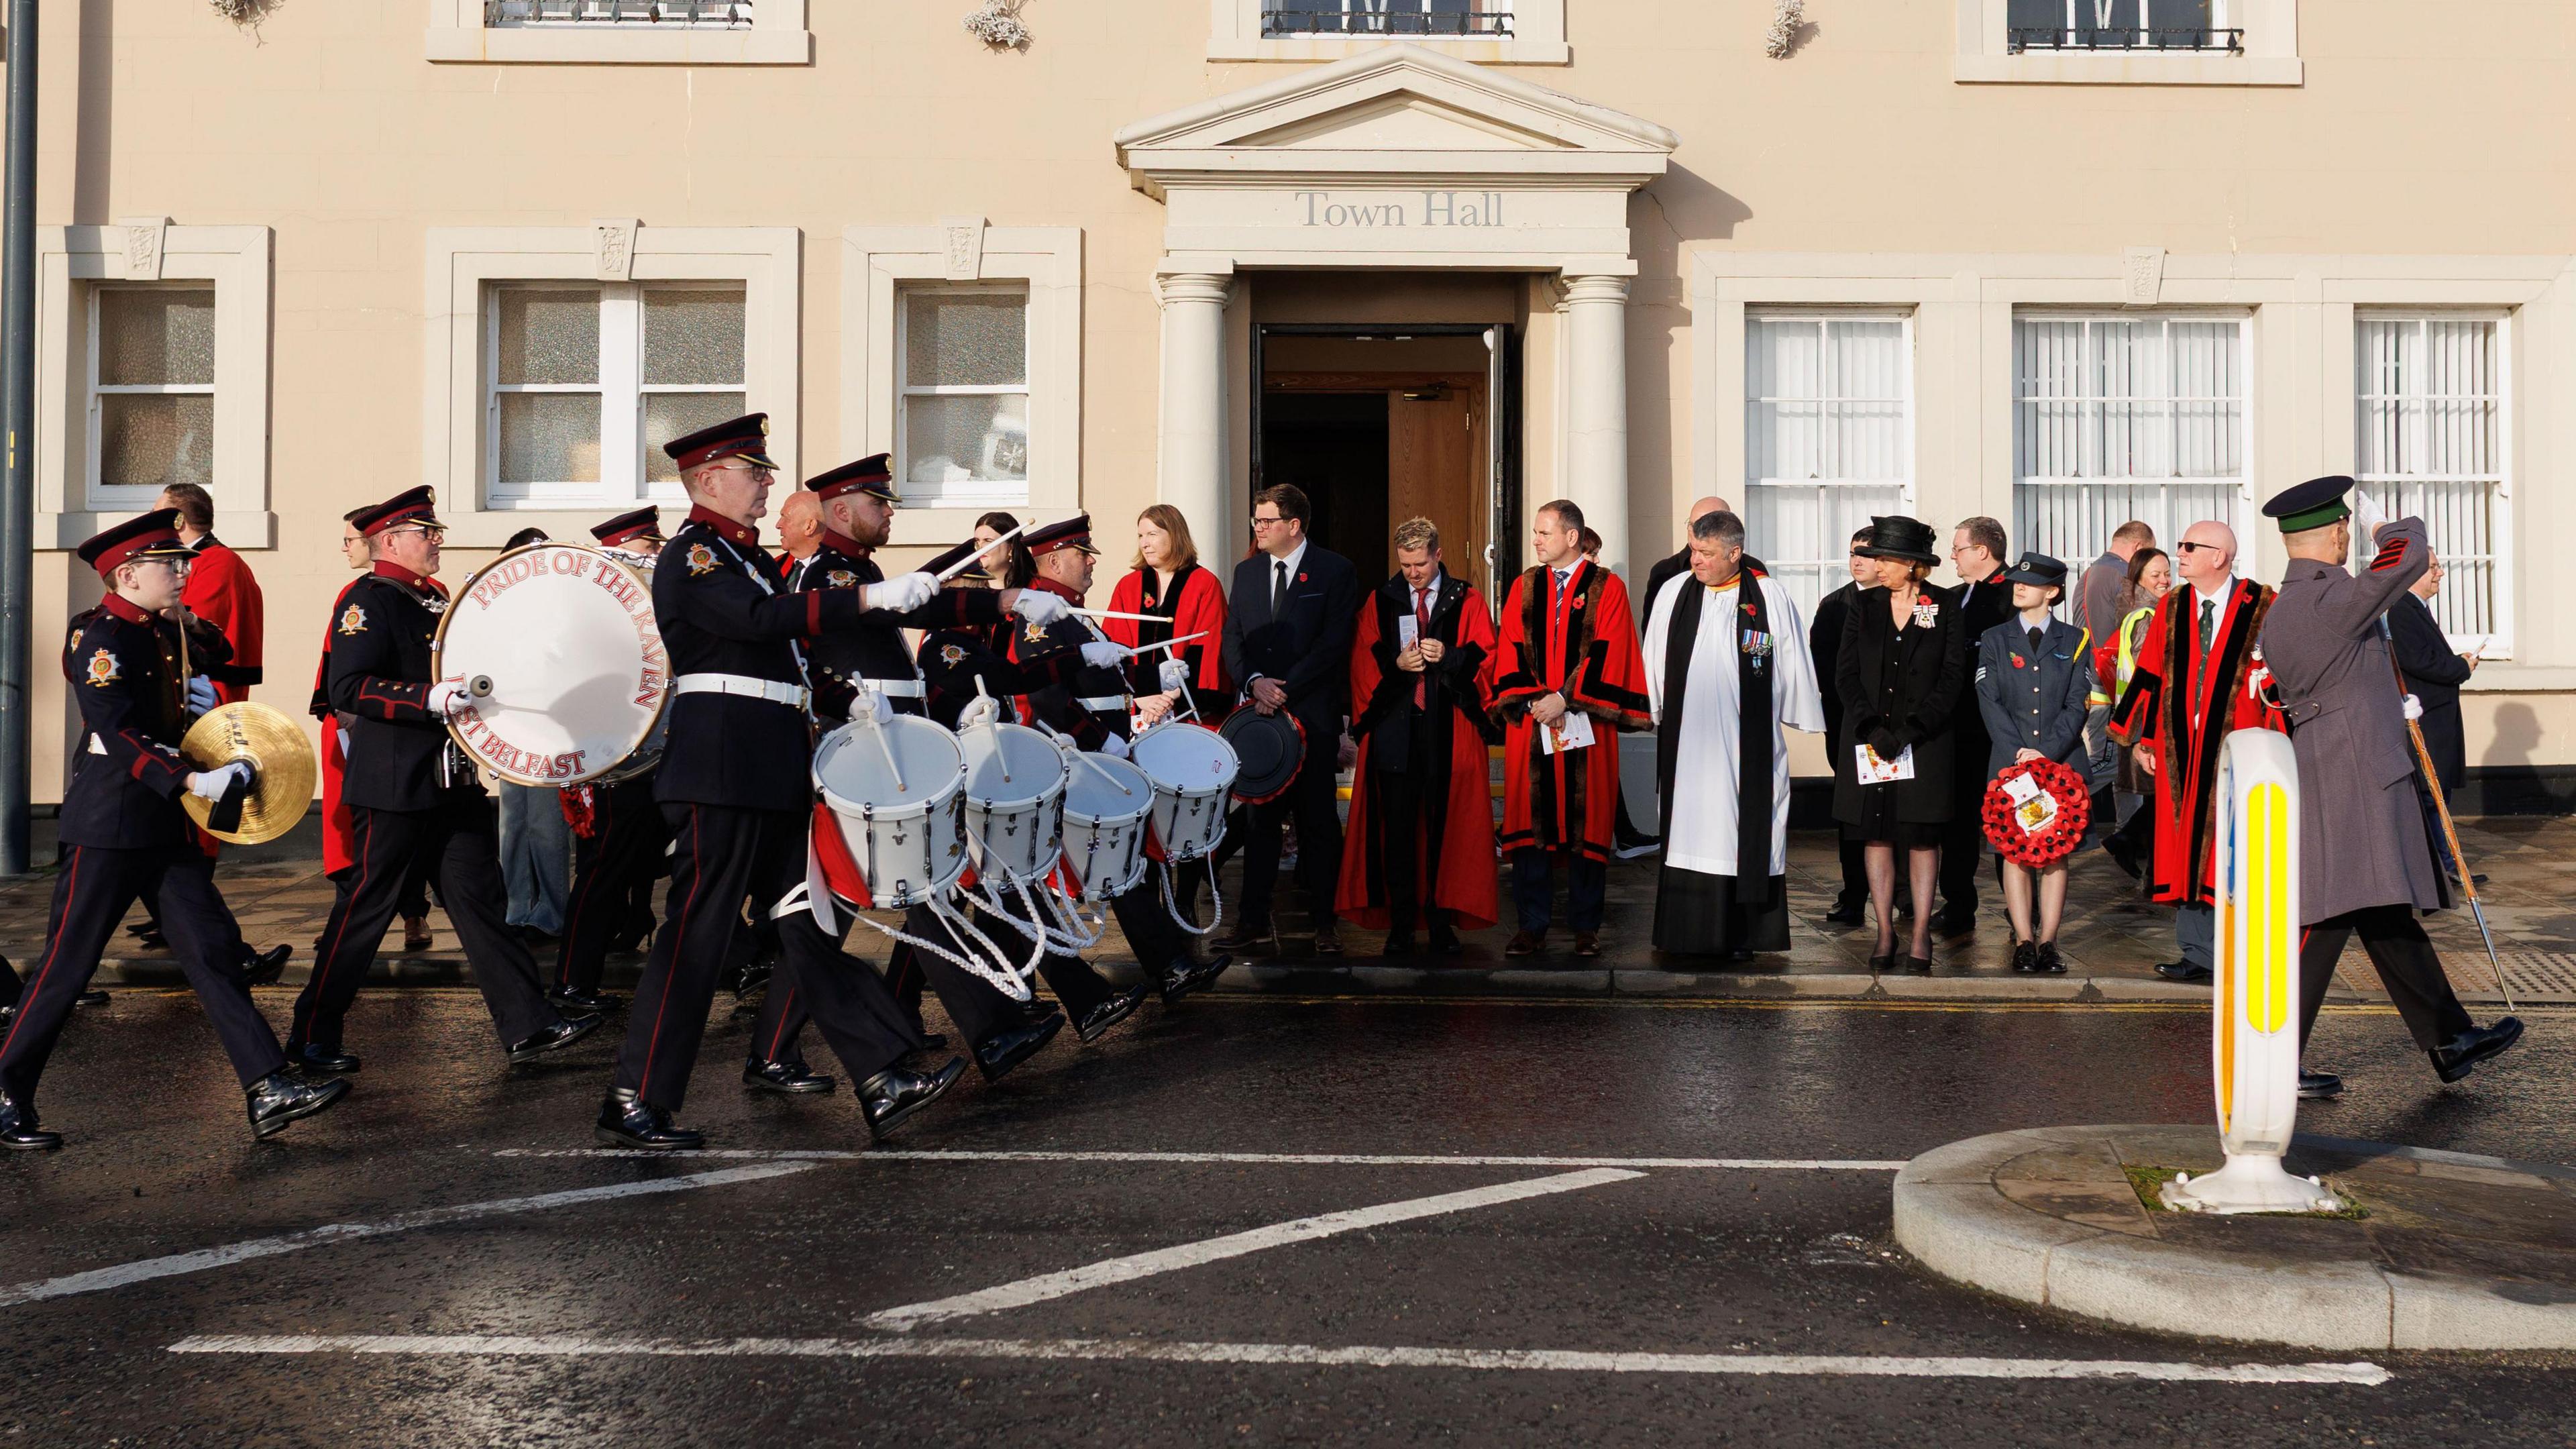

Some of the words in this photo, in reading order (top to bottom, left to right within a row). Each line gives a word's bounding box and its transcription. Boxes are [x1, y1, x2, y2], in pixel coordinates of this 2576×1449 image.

[1295, 192, 1407, 227] Town
[1421, 192, 1505, 227] Hall
[469, 552, 549, 610] PRIDE
[552, 551, 592, 577] OF
[593, 560, 645, 612] THE
[632, 606, 665, 711] RAVEN
[445, 673, 488, 739] EST
[478, 731, 586, 778] BELFAST
